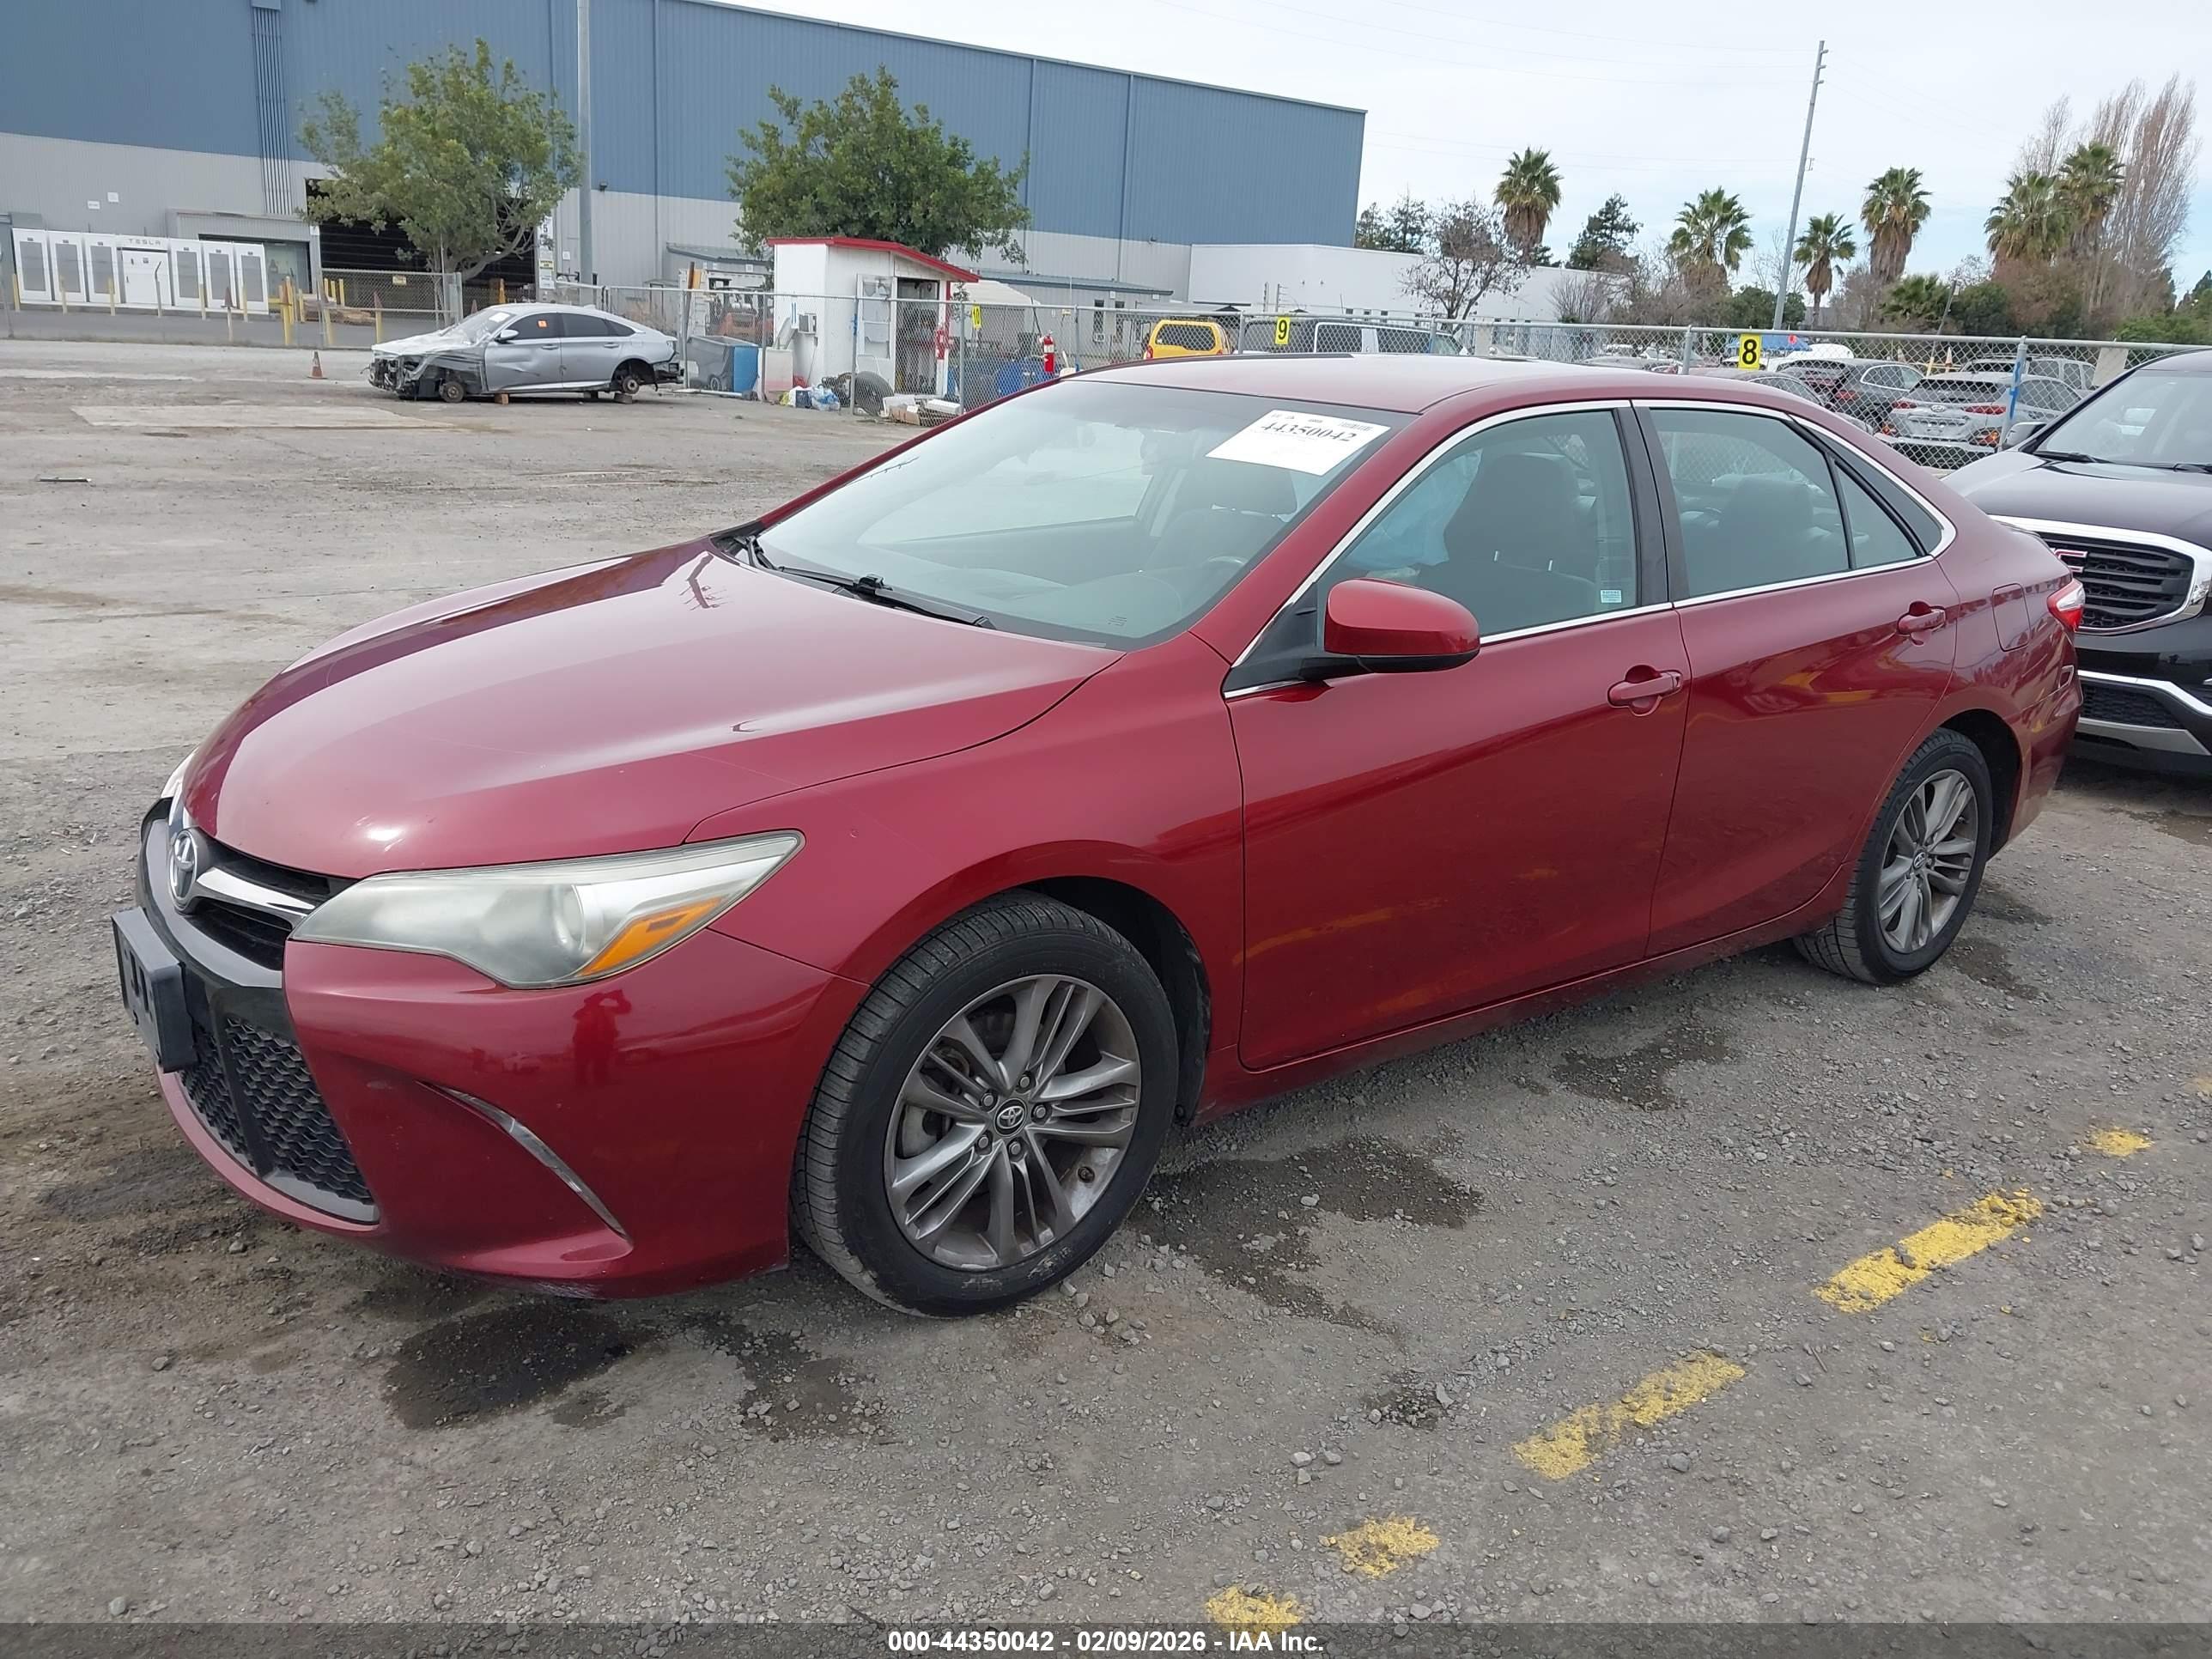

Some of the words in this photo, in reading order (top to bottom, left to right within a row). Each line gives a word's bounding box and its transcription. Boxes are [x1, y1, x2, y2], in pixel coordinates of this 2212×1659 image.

[973, 307, 980, 325] 10
[1279, 319, 1288, 340] 9
[1742, 339, 1757, 365] 8
[1261, 422, 1358, 442] 44350042
